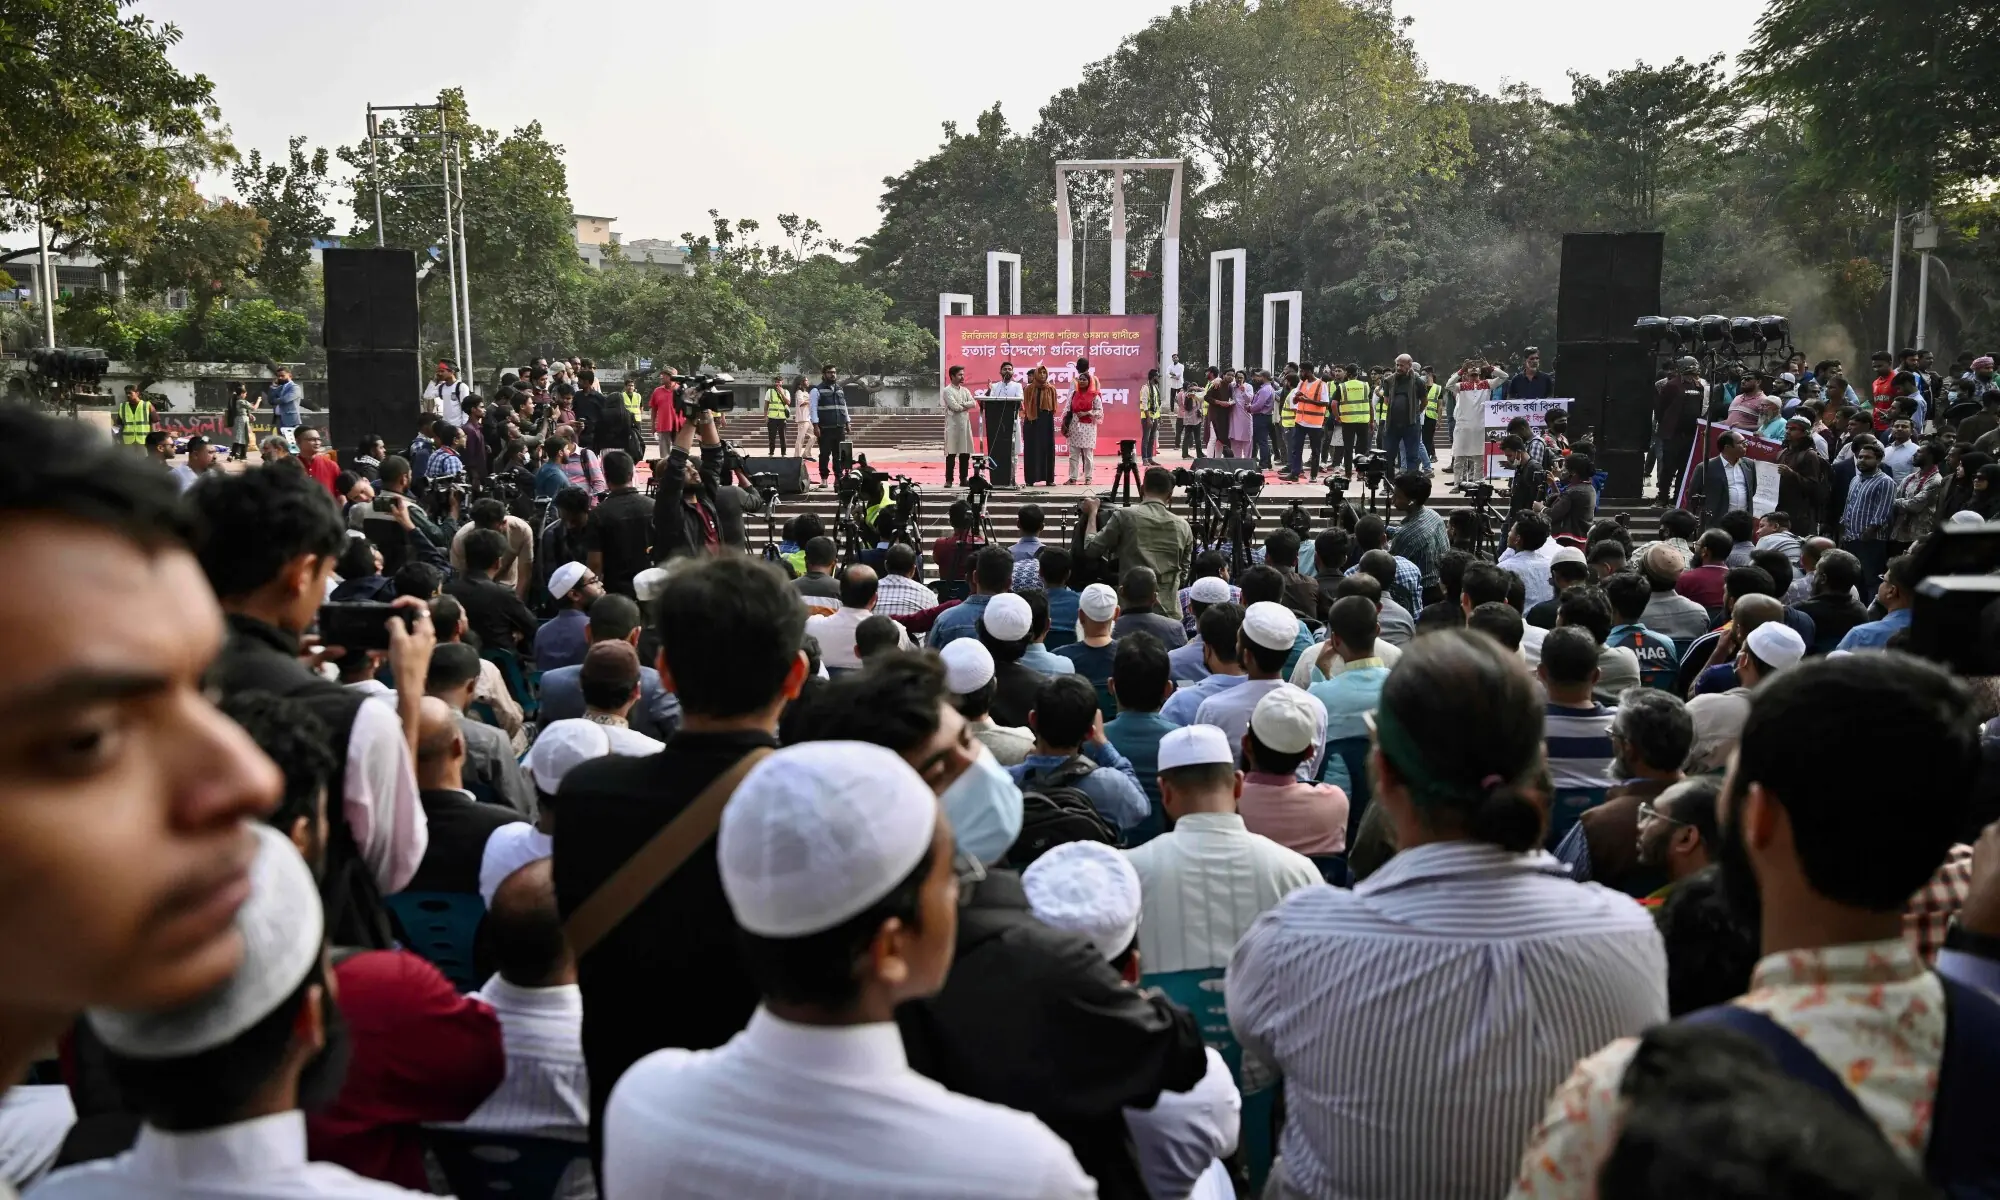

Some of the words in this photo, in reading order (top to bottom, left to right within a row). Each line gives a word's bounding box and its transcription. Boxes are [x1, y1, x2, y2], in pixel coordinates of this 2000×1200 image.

[961, 330, 998, 341] ইনকিলাব
[1000, 331, 1024, 340] মঞ্চের
[1057, 330, 1079, 340] শরিফ
[1083, 331, 1109, 340] ওসমান
[1112, 329, 1140, 340] হাদীকে
[961, 344, 996, 357] হত্যার
[1000, 342, 1046, 357] উদ্দেশ্যে
[1050, 342, 1085, 357] গুলির
[1089, 342, 1140, 357] প্রতিবাদে
[1490, 401, 1521, 415] গুলিবিদ্ধ
[1522, 400, 1538, 412] বর্ষা
